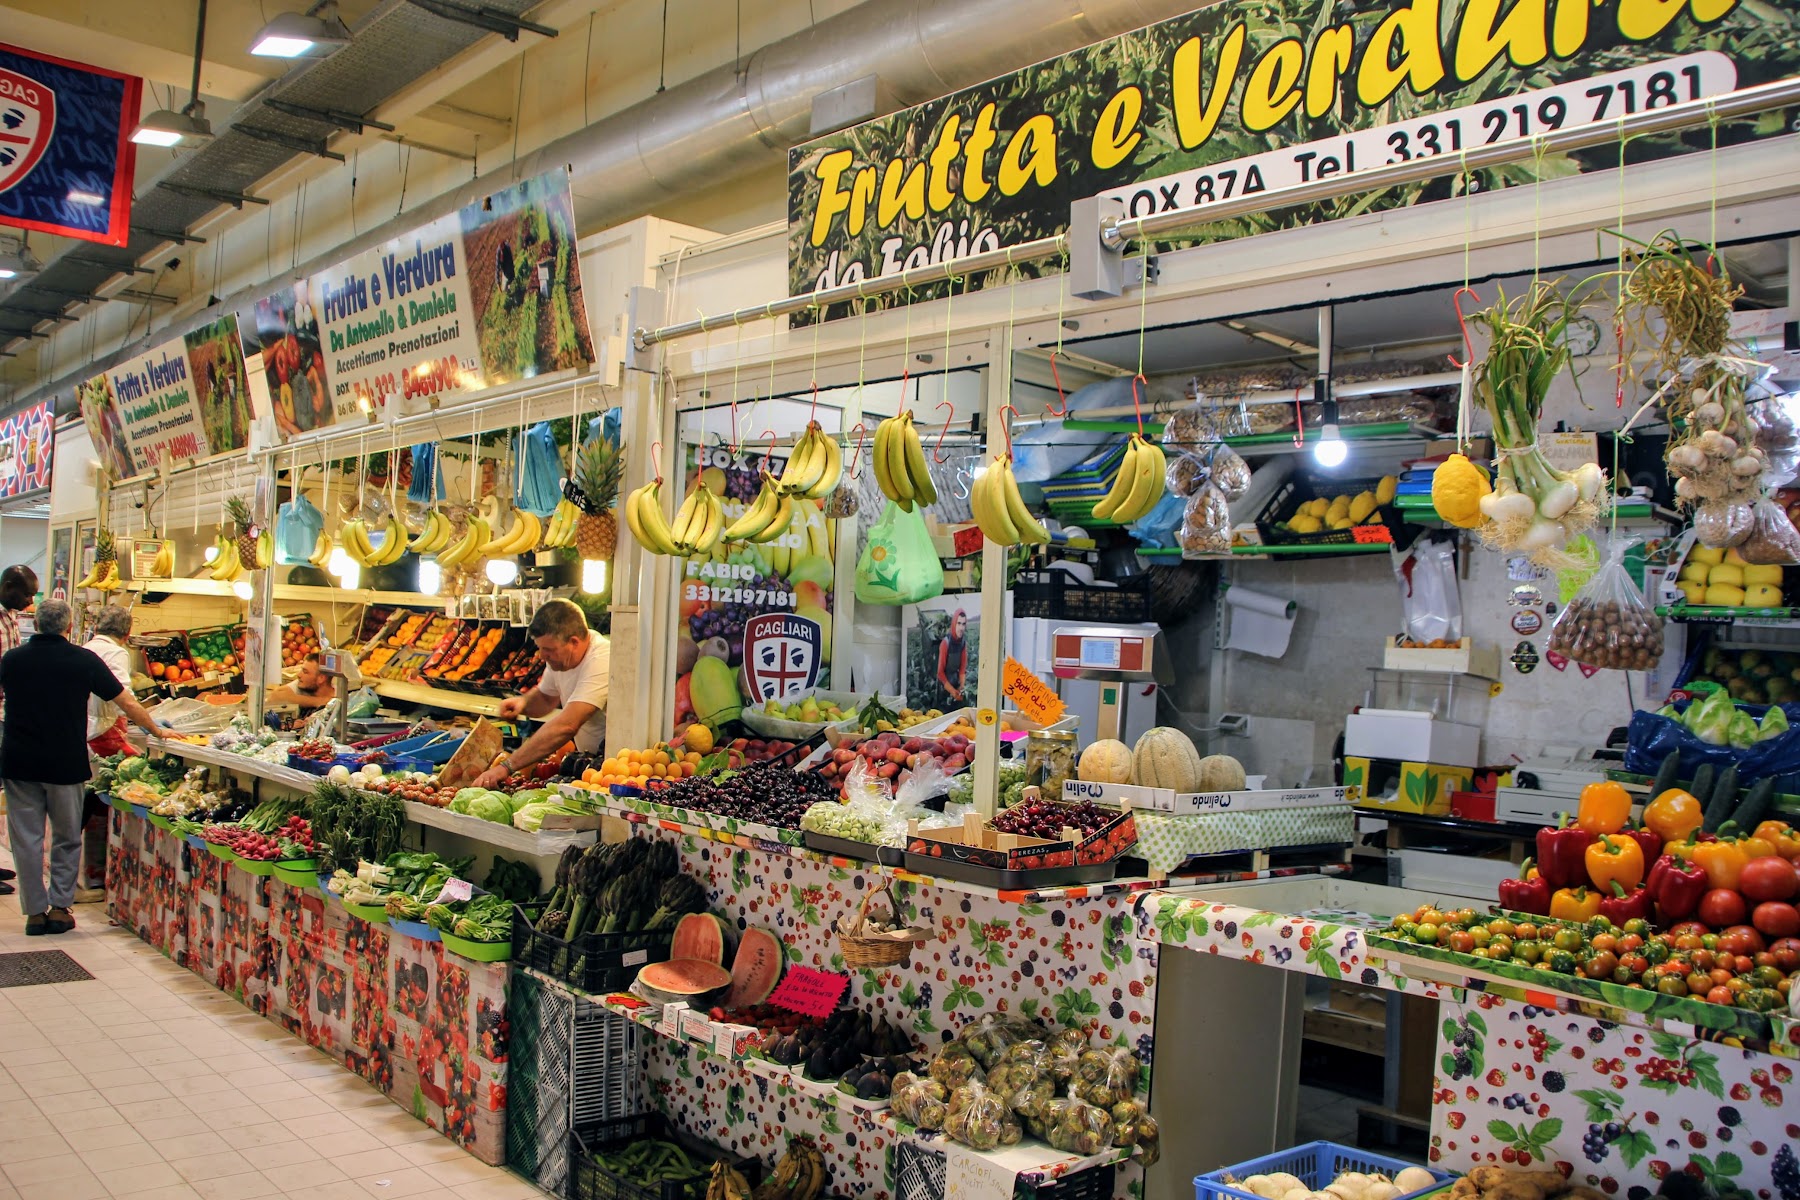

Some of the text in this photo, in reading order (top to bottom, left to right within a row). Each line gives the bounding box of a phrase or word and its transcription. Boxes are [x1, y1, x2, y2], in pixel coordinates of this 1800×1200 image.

[1109, 182, 1181, 219] OX
[1194, 164, 1266, 206] 87A
[1386, 119, 1461, 165] 331
[1482, 96, 1567, 145] 219
[1585, 65, 1702, 122] 7181
[811, 102, 1059, 248] Frutta
[1089, 85, 1143, 170] e
[322, 239, 455, 324] Frutta e Verdura
[330, 287, 457, 352] Da Antonello & Daniela
[336, 320, 460, 375] Accettiamo Prenotazioni
[114, 352, 187, 405] Frutta e Verdura
[336, 382, 350, 397] BOX
[158, 409, 194, 432] Prenotazioni
[694, 447, 750, 471] BOX
[686, 560, 755, 580] FABIO
[685, 585, 797, 607] 3312197181
[755, 621, 812, 641] CAGLIARI
[1192, 794, 1231, 809] Melinda
